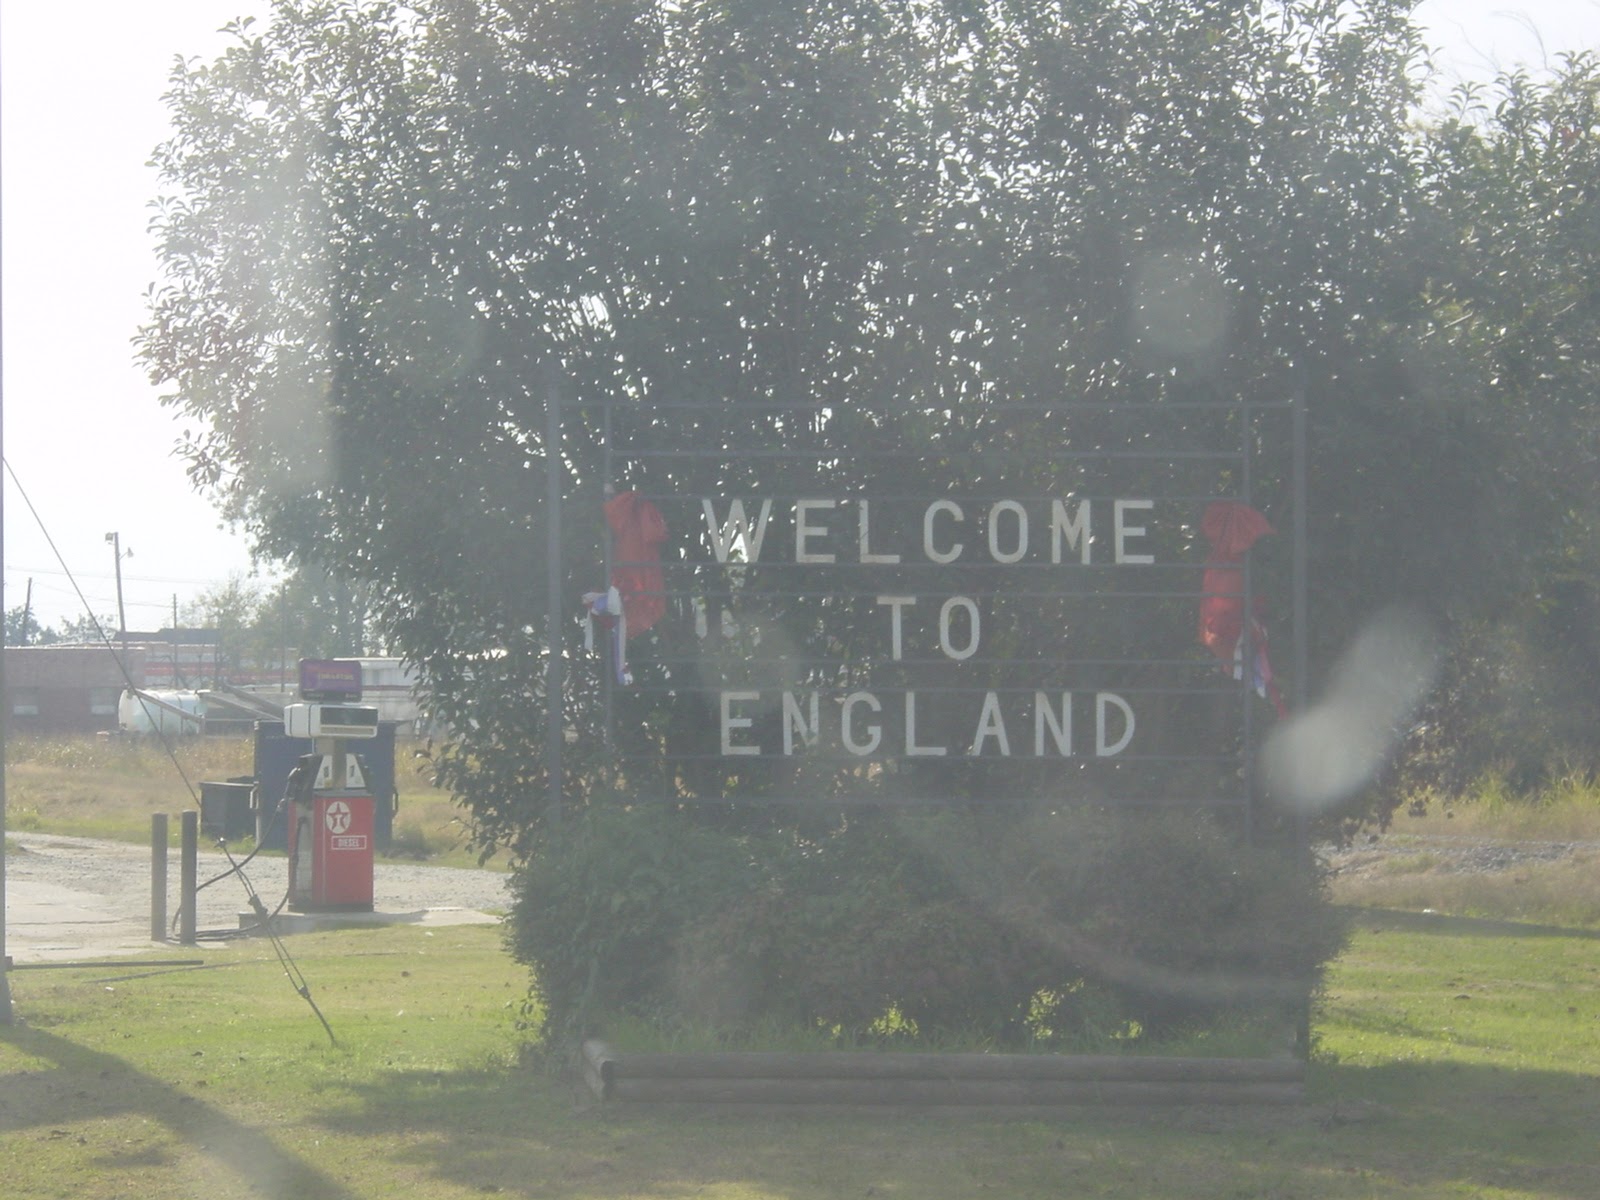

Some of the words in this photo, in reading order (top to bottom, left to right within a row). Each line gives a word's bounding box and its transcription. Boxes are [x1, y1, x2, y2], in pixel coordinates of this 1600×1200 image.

[702, 499, 1155, 565] WELCOME
[877, 596, 981, 661] TO
[720, 691, 1136, 757] ENGLAND
[338, 838, 359, 848] DIESEL
